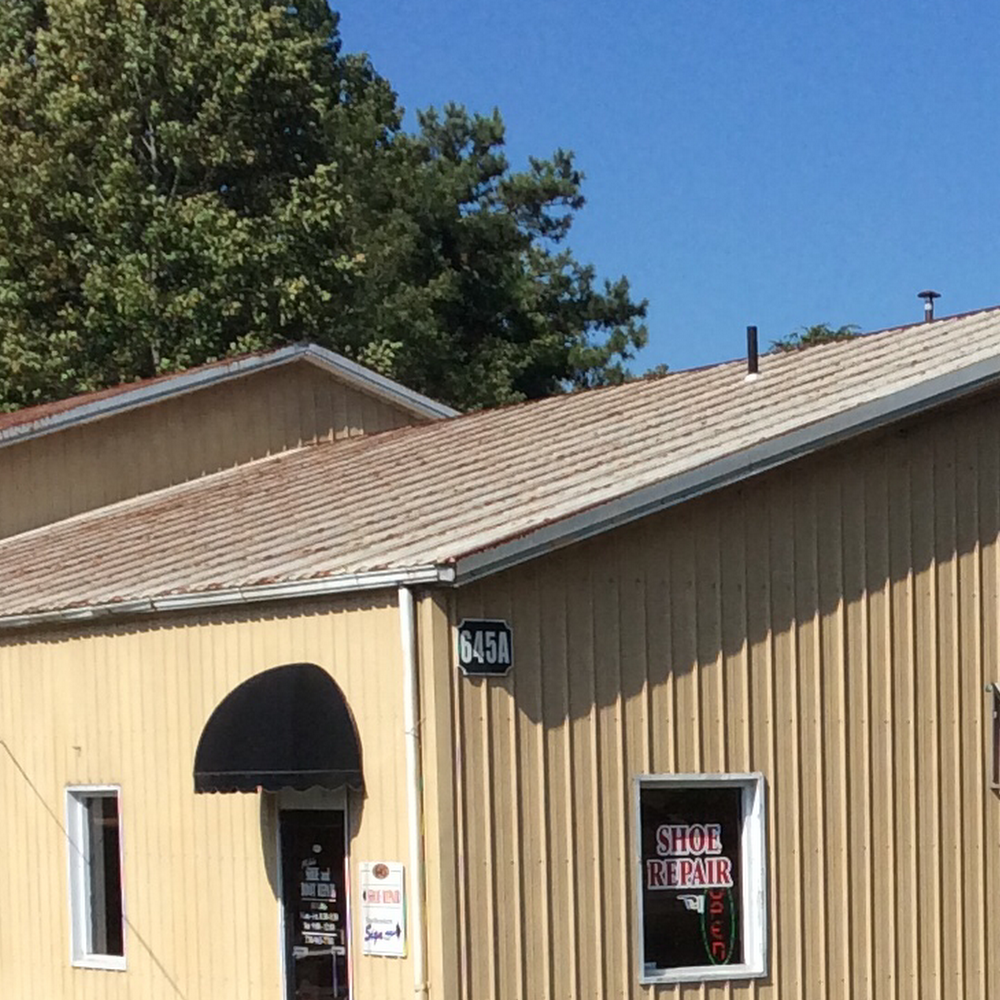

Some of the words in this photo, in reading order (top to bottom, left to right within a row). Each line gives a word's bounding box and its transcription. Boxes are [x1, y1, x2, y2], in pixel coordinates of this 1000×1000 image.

[460, 630, 511, 664] 645A
[656, 824, 723, 856] SHOE
[646, 856, 734, 890] REPAIR
